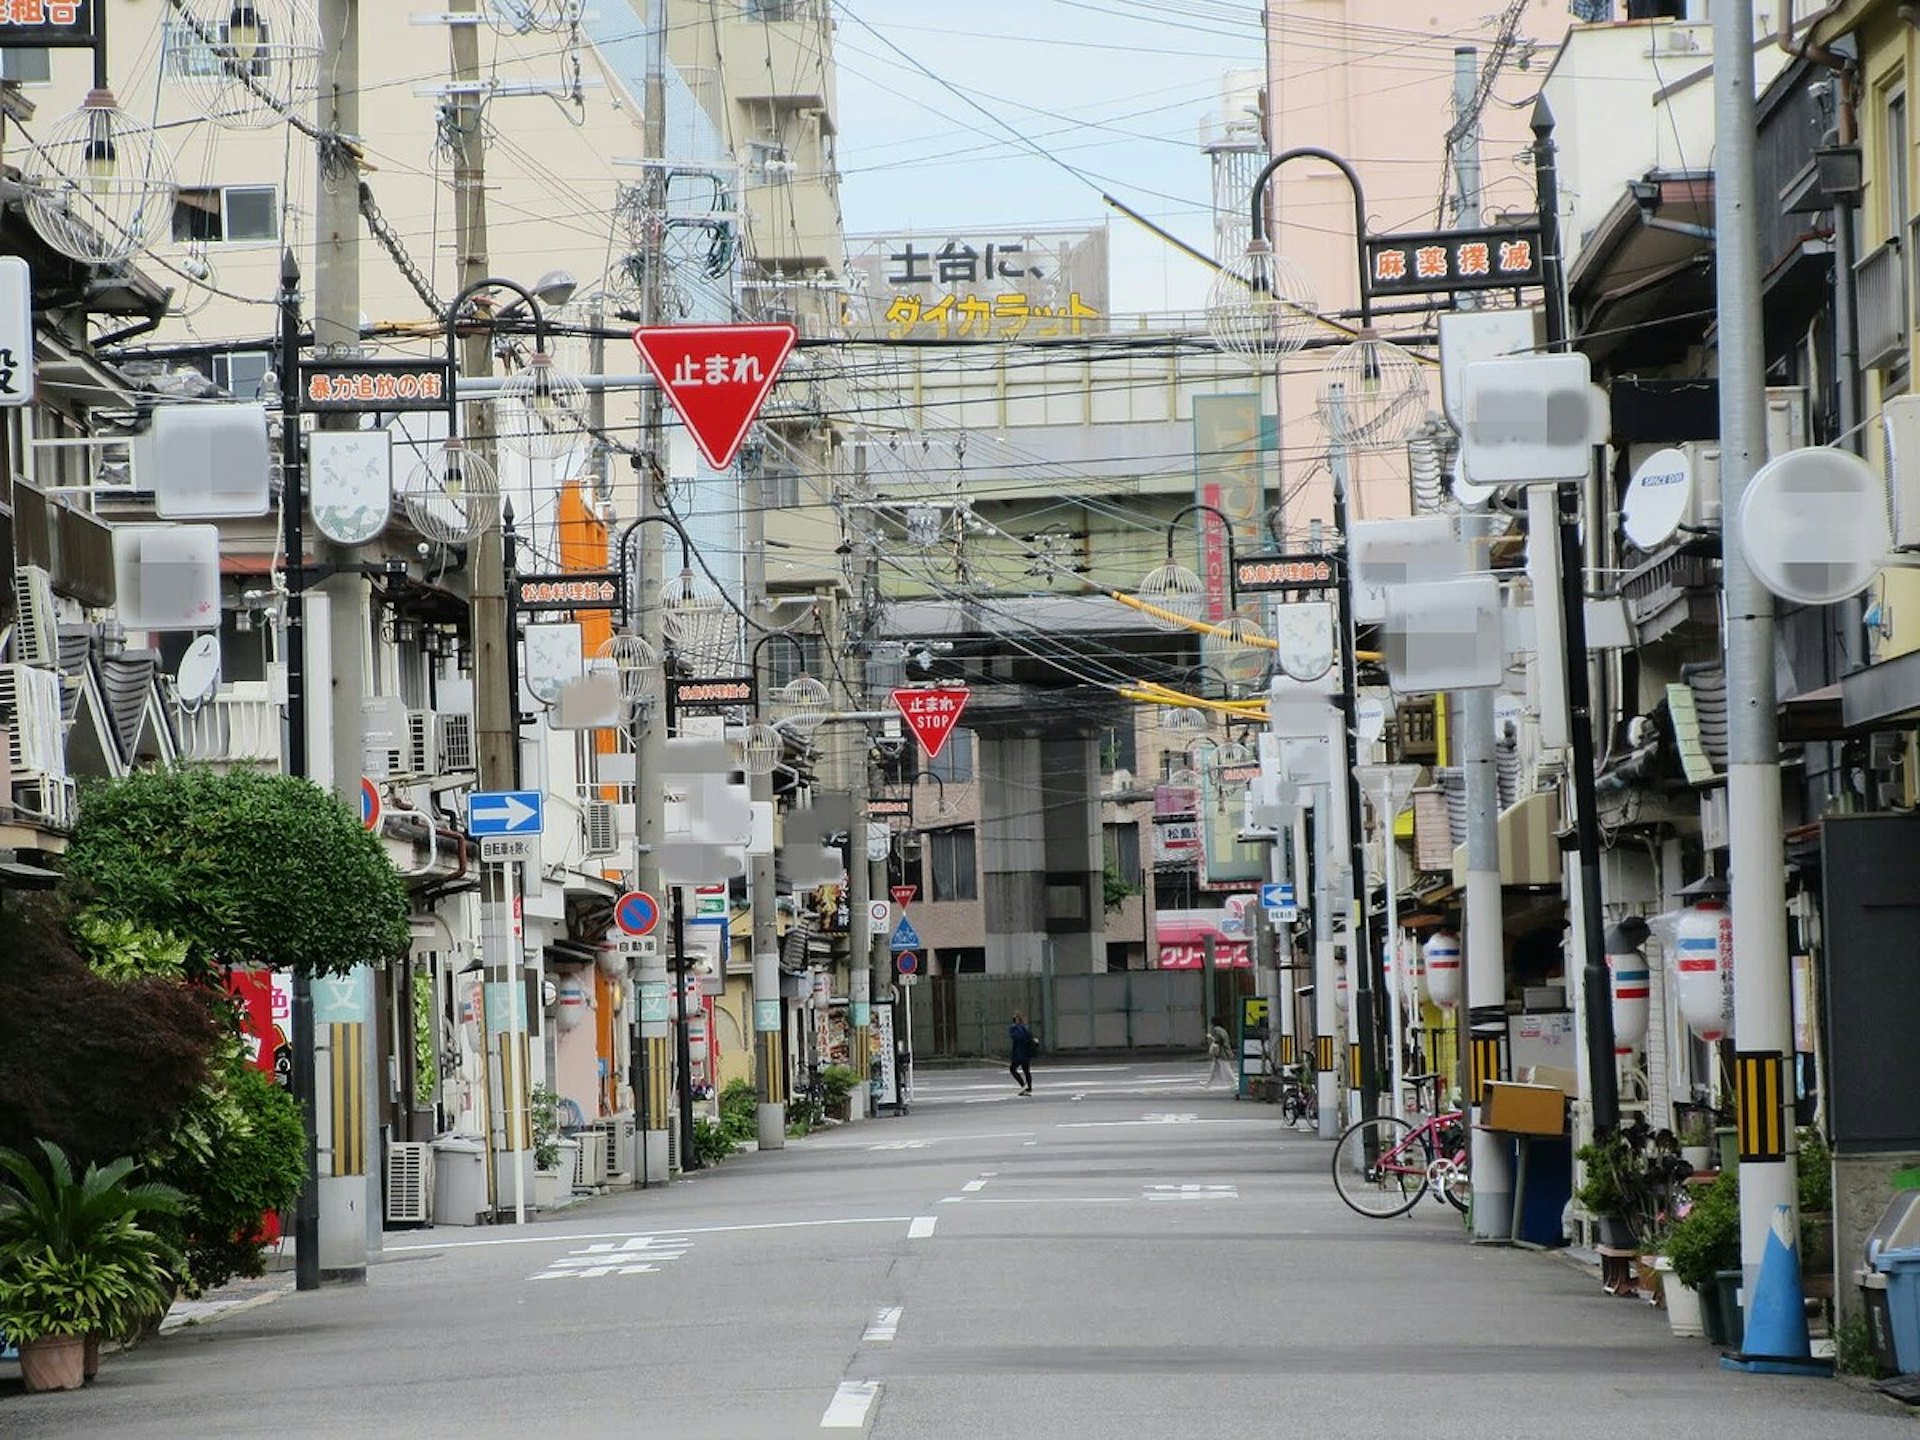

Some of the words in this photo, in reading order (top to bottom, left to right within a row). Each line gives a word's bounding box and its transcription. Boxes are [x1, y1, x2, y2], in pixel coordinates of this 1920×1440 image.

[0, 0, 83, 25] 組合
[889, 242, 1045, 284] 土台に、
[1375, 240, 1533, 279] 麻薬撲滅
[884, 292, 1101, 339] ダイカラット
[670, 353, 765, 386] 止まれ
[309, 373, 442, 401] 暴力追放の街
[1239, 561, 1332, 584] 松島料理組合
[520, 581, 616, 602] 松島料理組合
[908, 696, 956, 713] 止まれ
[917, 715, 949, 728] STOP
[1167, 826, 1197, 839] 松島
[483, 841, 530, 857] 自転車を除く
[618, 940, 655, 953] 自動車
